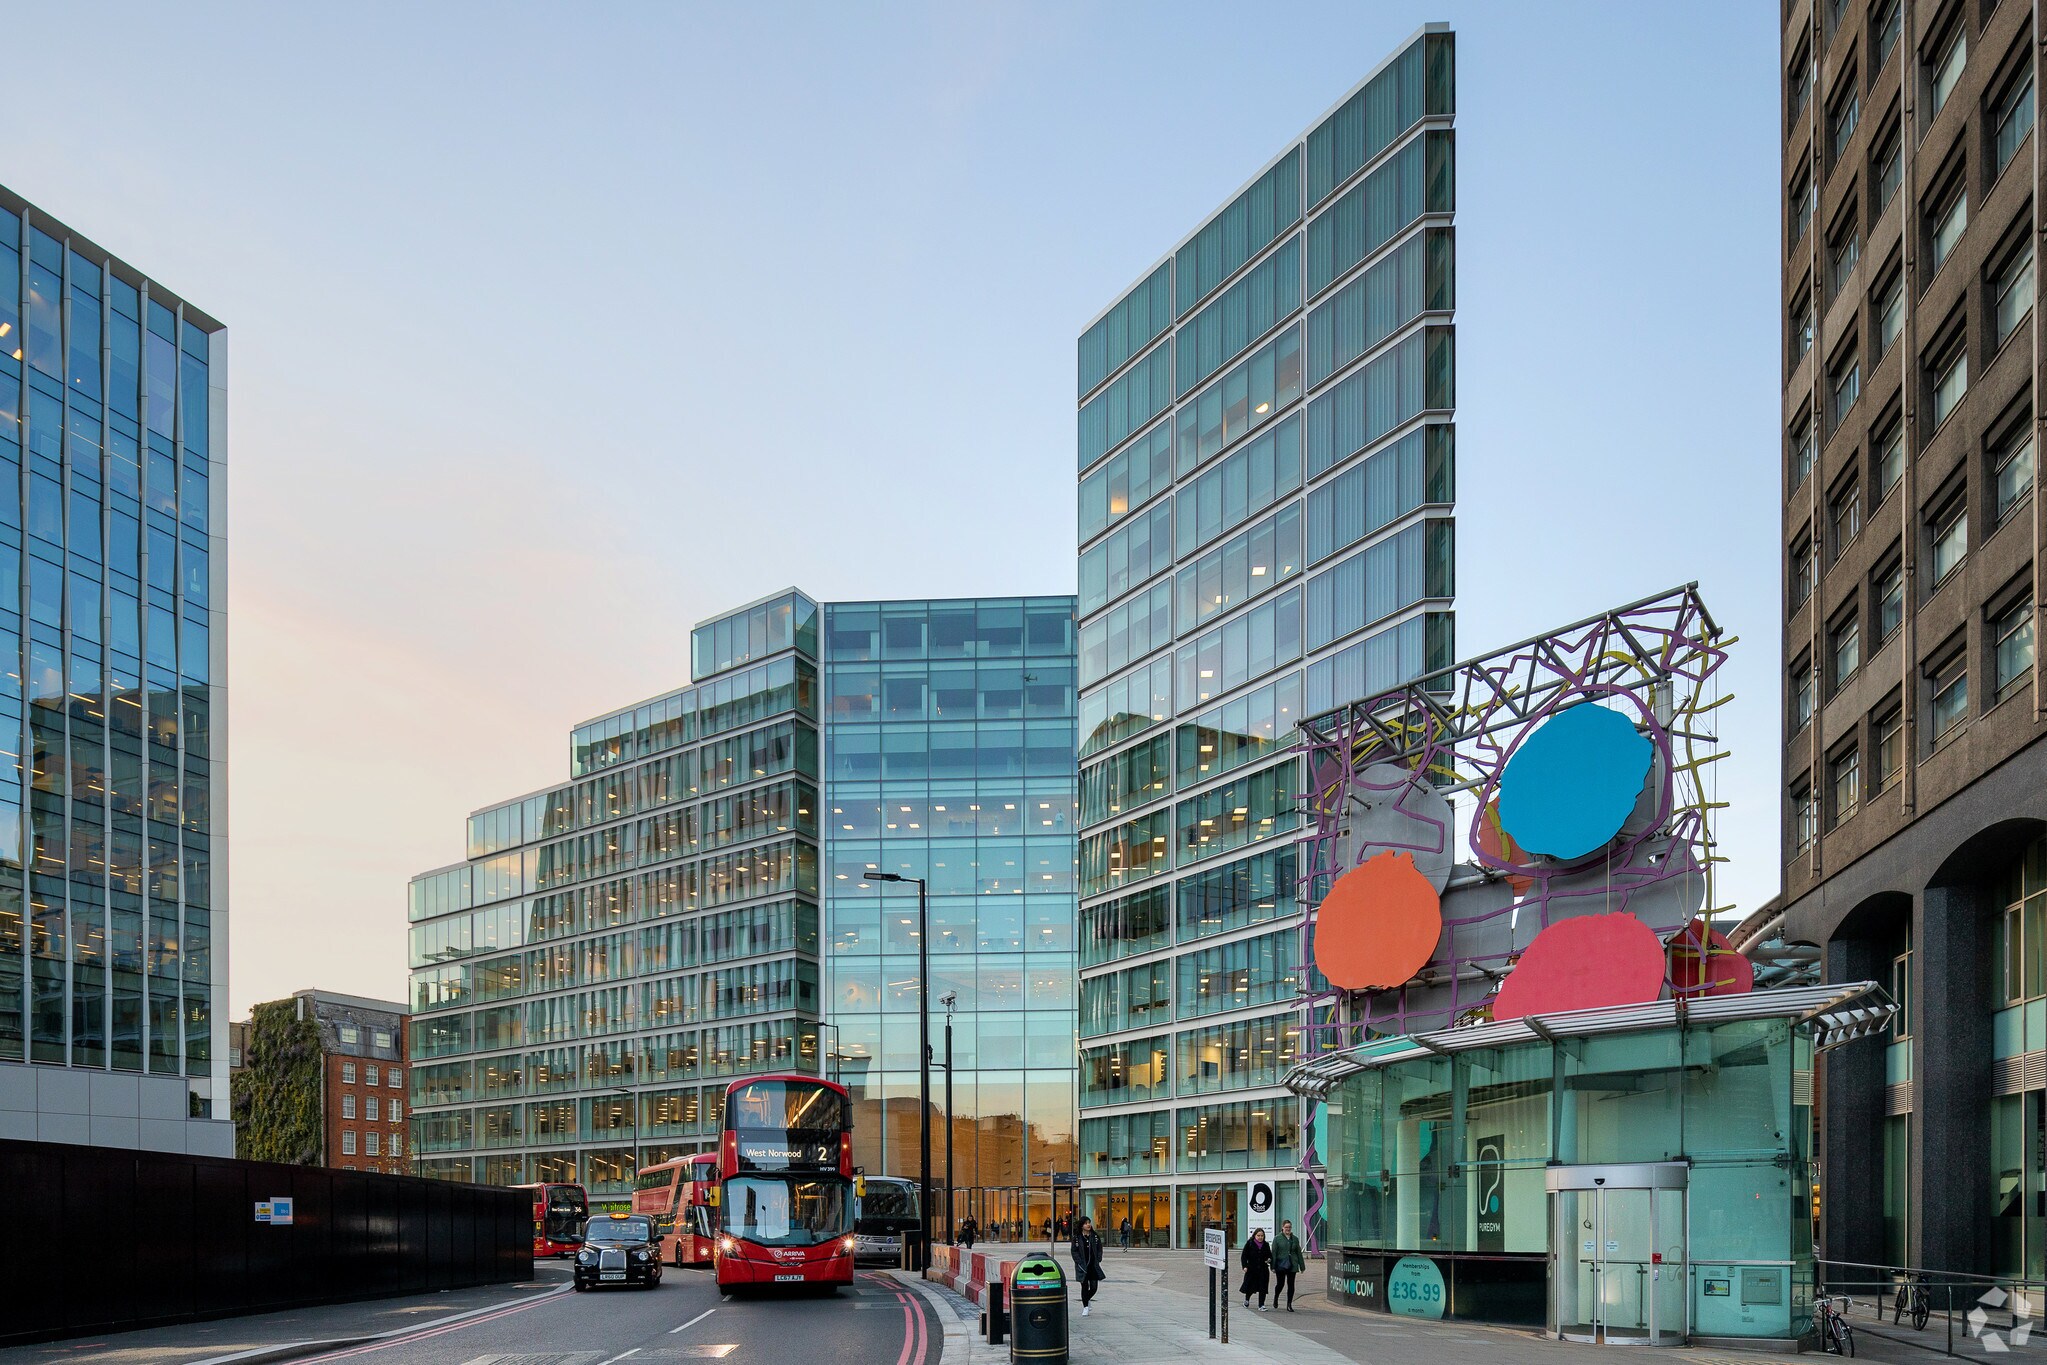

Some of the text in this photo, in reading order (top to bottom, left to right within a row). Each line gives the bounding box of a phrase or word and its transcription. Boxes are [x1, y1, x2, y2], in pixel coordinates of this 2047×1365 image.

[746, 1149, 802, 1158] West Norwood
[817, 1146, 828, 1161] 2
[1479, 1223, 1501, 1232] PUREGYM
[1392, 1281, 1440, 1302] £36.99
